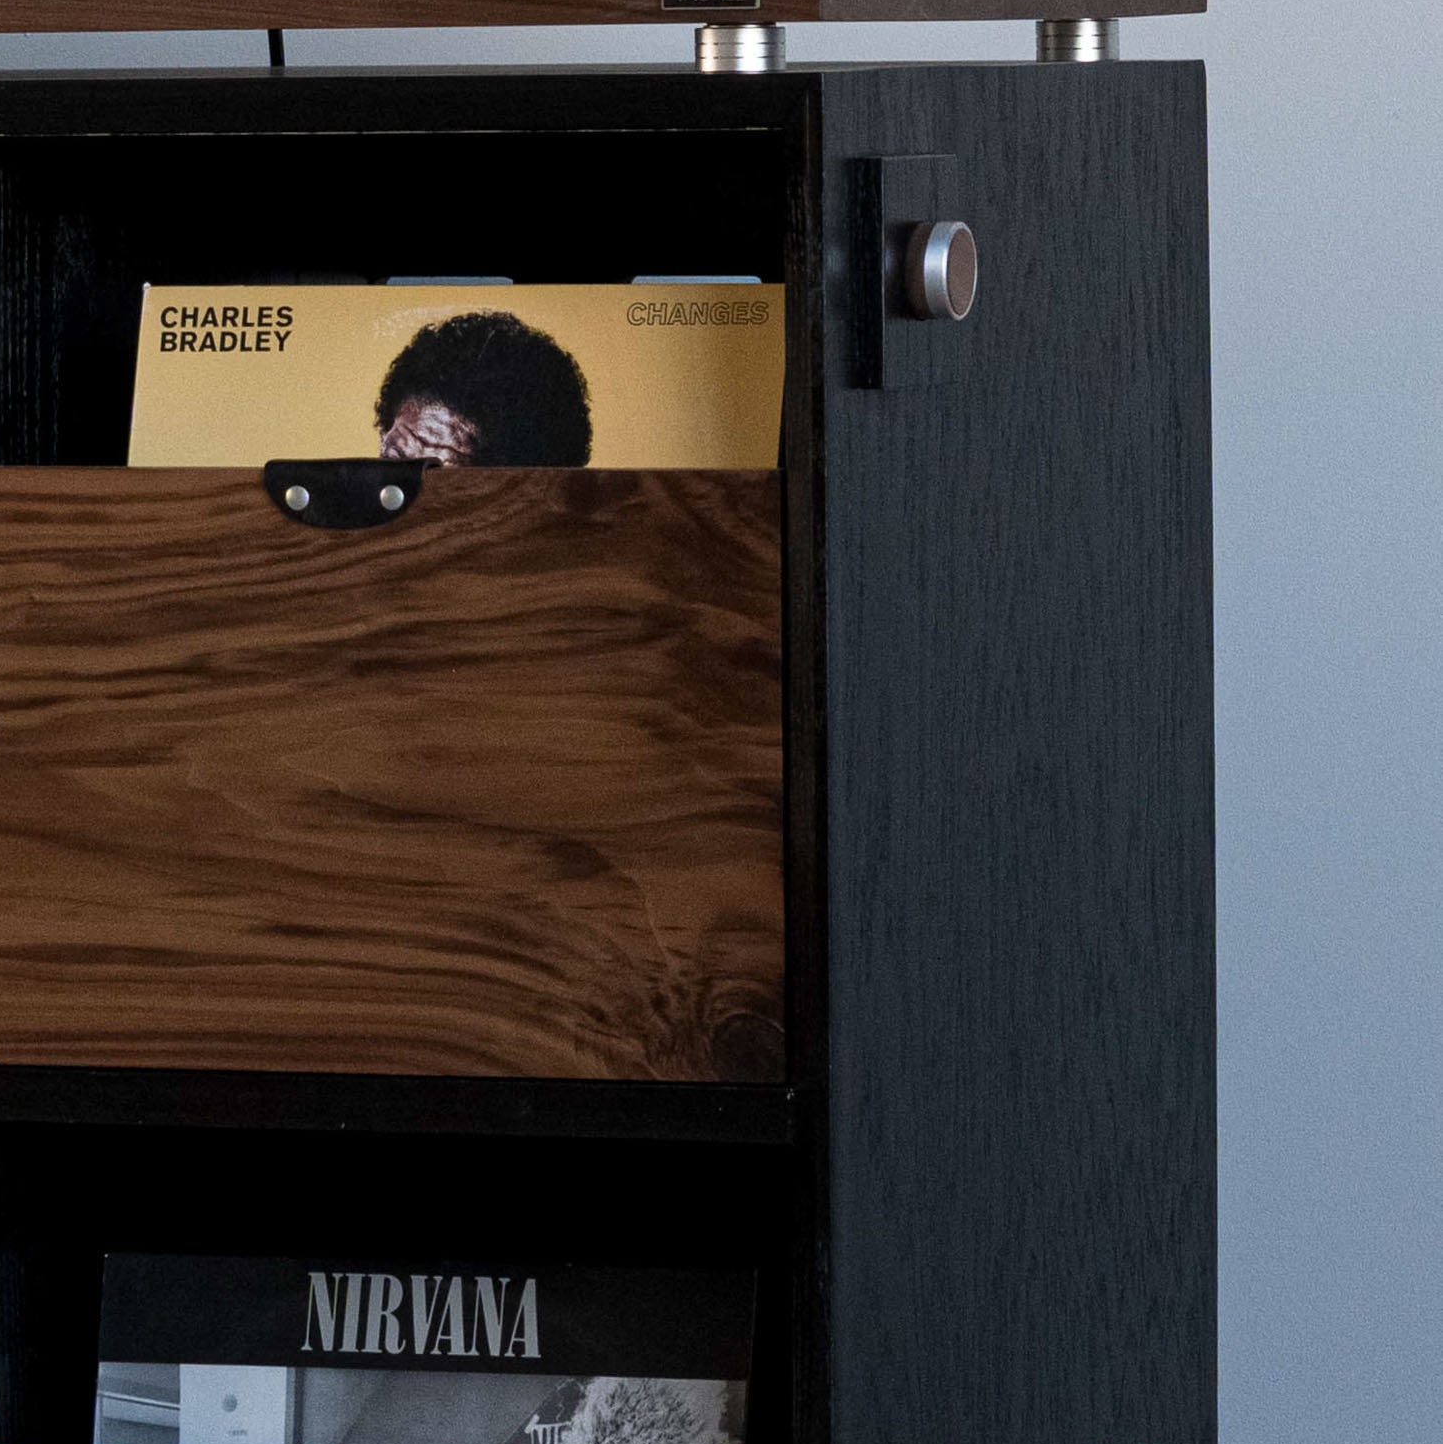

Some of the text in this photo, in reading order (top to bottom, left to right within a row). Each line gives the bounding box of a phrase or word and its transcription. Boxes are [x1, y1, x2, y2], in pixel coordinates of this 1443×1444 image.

[160, 306, 294, 328] CHARLES
[626, 301, 770, 326] CHANGES
[160, 330, 292, 352] BRADLEY
[300, 1272, 542, 1358] NIRVANA
